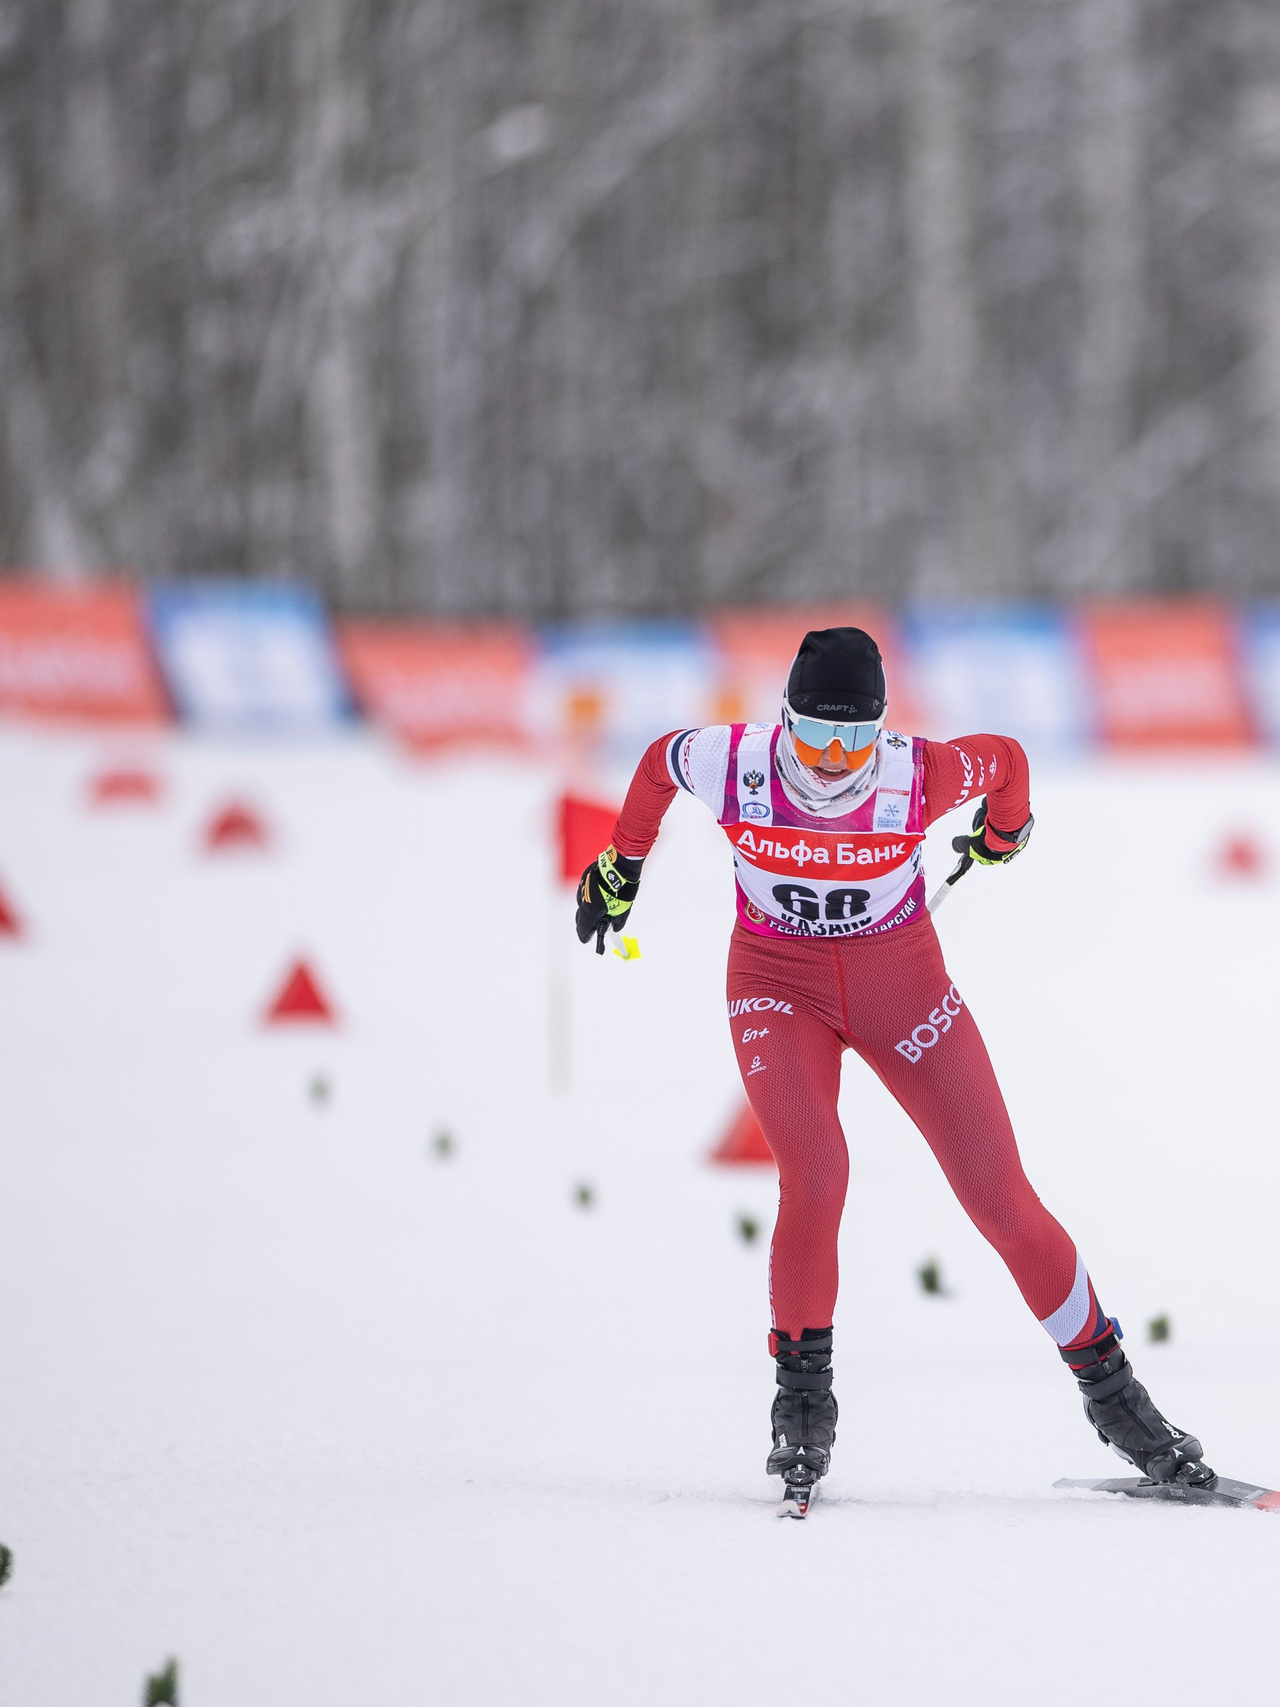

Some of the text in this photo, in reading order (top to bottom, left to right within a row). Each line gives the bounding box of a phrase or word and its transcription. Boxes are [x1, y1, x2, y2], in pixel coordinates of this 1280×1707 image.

[816, 704, 850, 712] CRAFT
[737, 829, 907, 867] Альфа Банк
[772, 883, 871, 921] 68
[894, 983, 963, 1064] BOSCO
